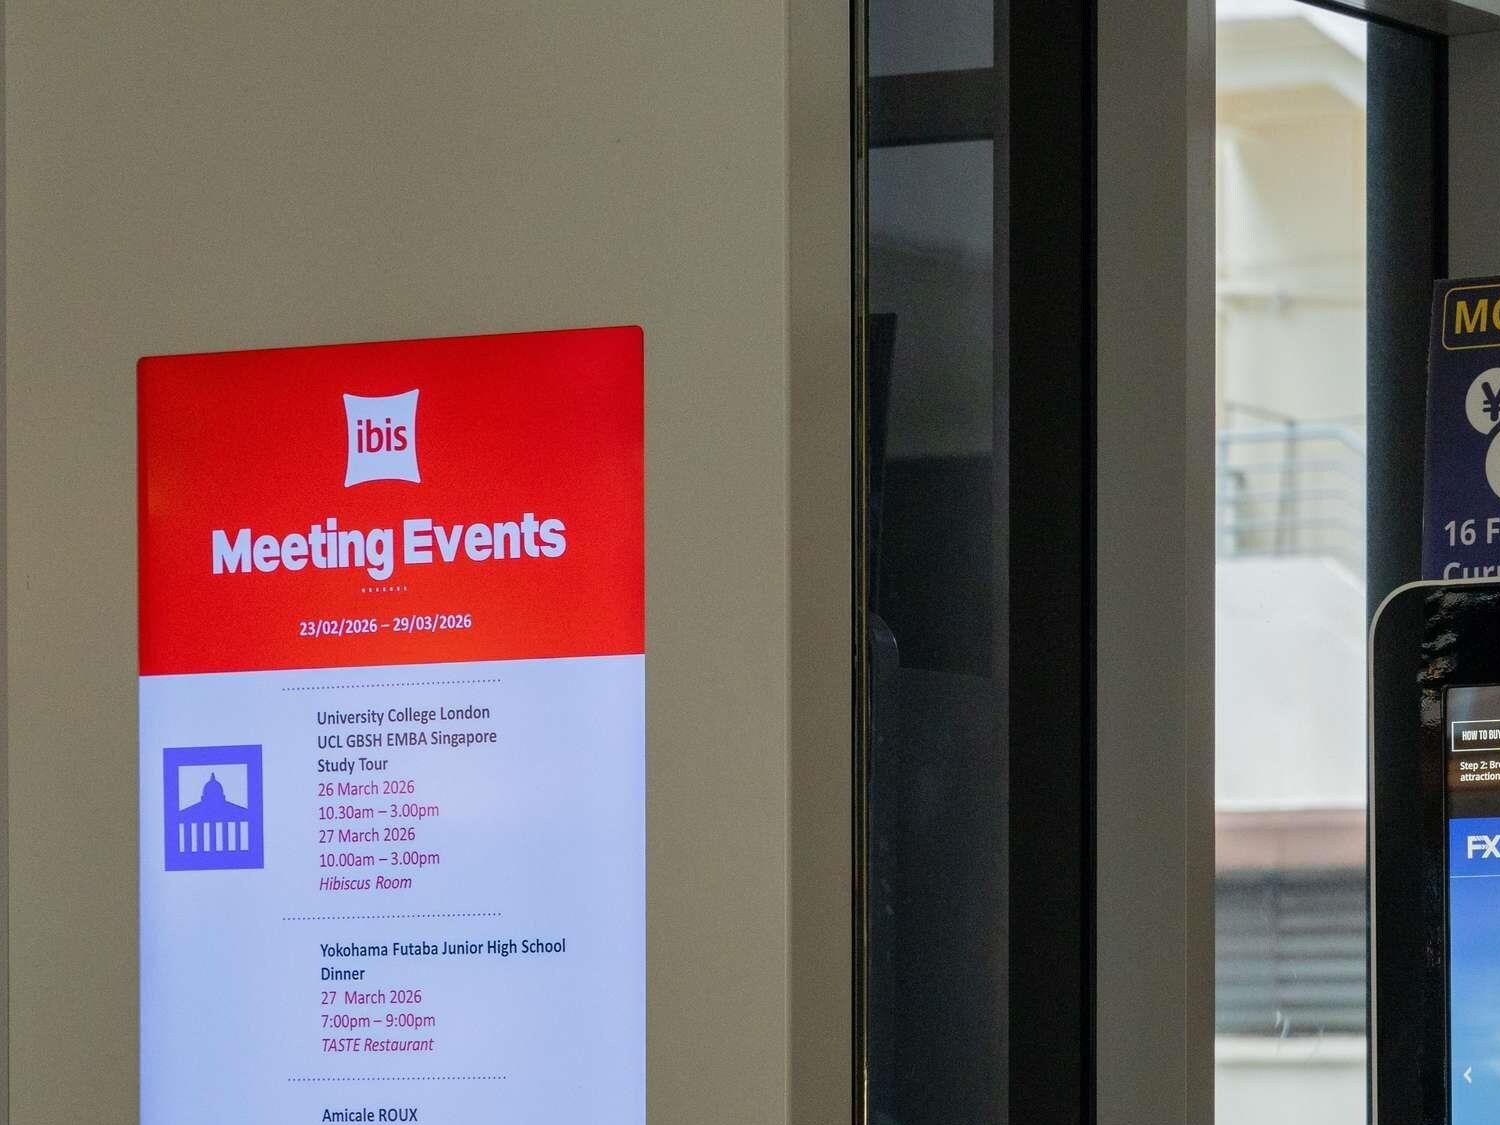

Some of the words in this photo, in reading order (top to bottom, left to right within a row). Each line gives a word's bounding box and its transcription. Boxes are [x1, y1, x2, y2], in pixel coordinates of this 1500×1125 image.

[357, 418, 407, 453] ibis
[1444, 519, 1477, 546] 16
[212, 517, 394, 581] Meeting
[403, 512, 566, 564] Events
[300, 618, 377, 638] 23/02/2026
[393, 613, 472, 633] 29/03/2026
[317, 709, 384, 726] University
[388, 707, 436, 724] College
[440, 705, 490, 720] London
[317, 735, 342, 749] UCL
[346, 733, 382, 748] GBSH
[387, 732, 427, 746] EMBA
[430, 731, 497, 747] Singapore
[1462, 731, 1478, 741] HOW
[1479, 730, 1488, 740] TO
[317, 757, 355, 775] Study
[359, 757, 388, 771] Tour
[1460, 761, 1479, 771] Step
[1480, 761, 1488, 770] 2:
[1460, 771, 1500, 782] attraction
[318, 783, 334, 796] 26
[338, 780, 378, 796] March
[383, 780, 415, 794] 2026
[319, 805, 374, 820] 10.30am
[390, 803, 439, 820] 3.00pm
[319, 830, 334, 843] 27
[338, 828, 379, 843] March
[384, 827, 415, 841] 2026
[320, 852, 375, 867] 10.00am
[390, 851, 440, 868] 3.00pm
[320, 875, 370, 891] Hibiscus
[376, 875, 412, 889] Room
[320, 942, 388, 957] Yokohama
[393, 941, 438, 956] Futaba
[442, 940, 483, 955] Junior
[487, 939, 517, 957] High
[521, 938, 566, 953] School
[320, 967, 365, 981] Dinner
[321, 991, 336, 1005] 27
[344, 989, 385, 1004] March
[390, 989, 422, 1003] 2026
[321, 1014, 370, 1031] 7:00pm
[386, 1013, 436, 1029] 9:00pm
[322, 1038, 361, 1052] TASTE
[364, 1037, 434, 1051] Restaurant
[322, 1108, 375, 1122] Amicale
[378, 1108, 418, 1122] ROUX
